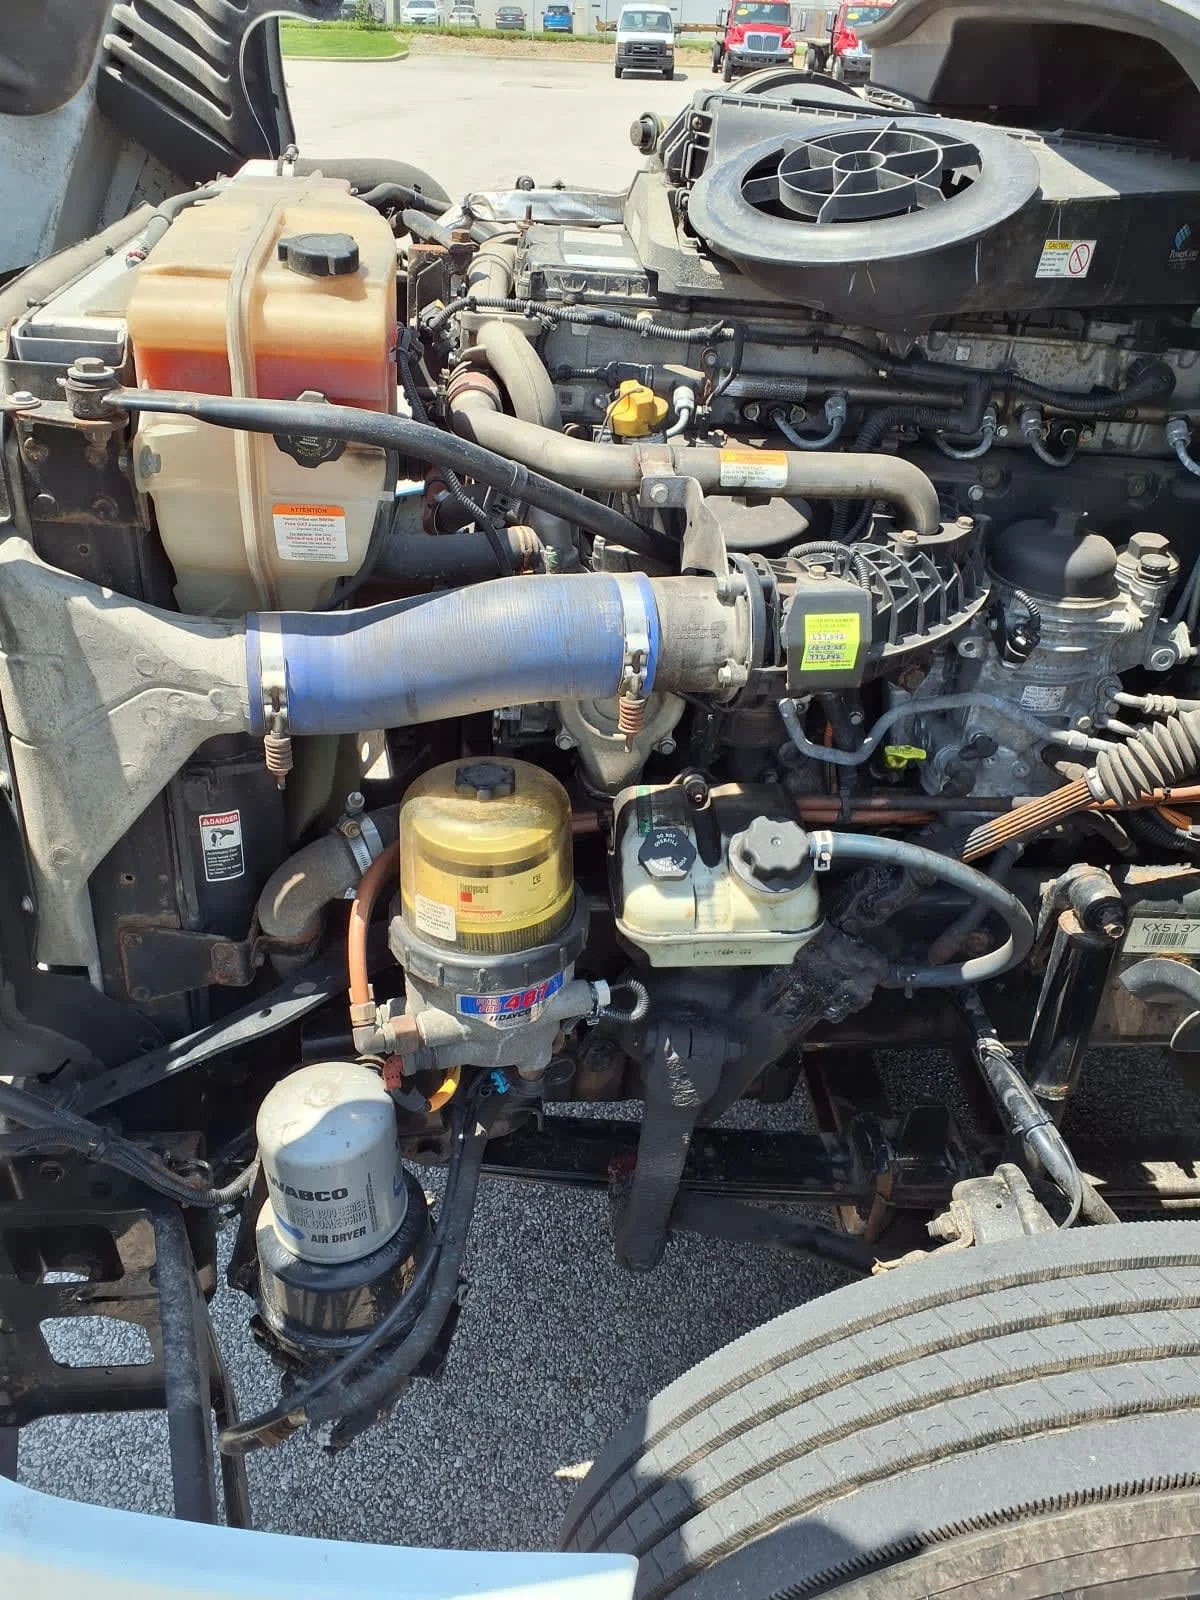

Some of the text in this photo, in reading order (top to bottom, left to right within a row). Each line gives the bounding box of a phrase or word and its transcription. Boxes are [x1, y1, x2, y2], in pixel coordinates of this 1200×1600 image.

[210, 814, 238, 825] DANGER
[498, 1007, 532, 1020] DAVCO
[268, 1172, 349, 1202] WABCO
[311, 1226, 367, 1244] AIR DRYER
